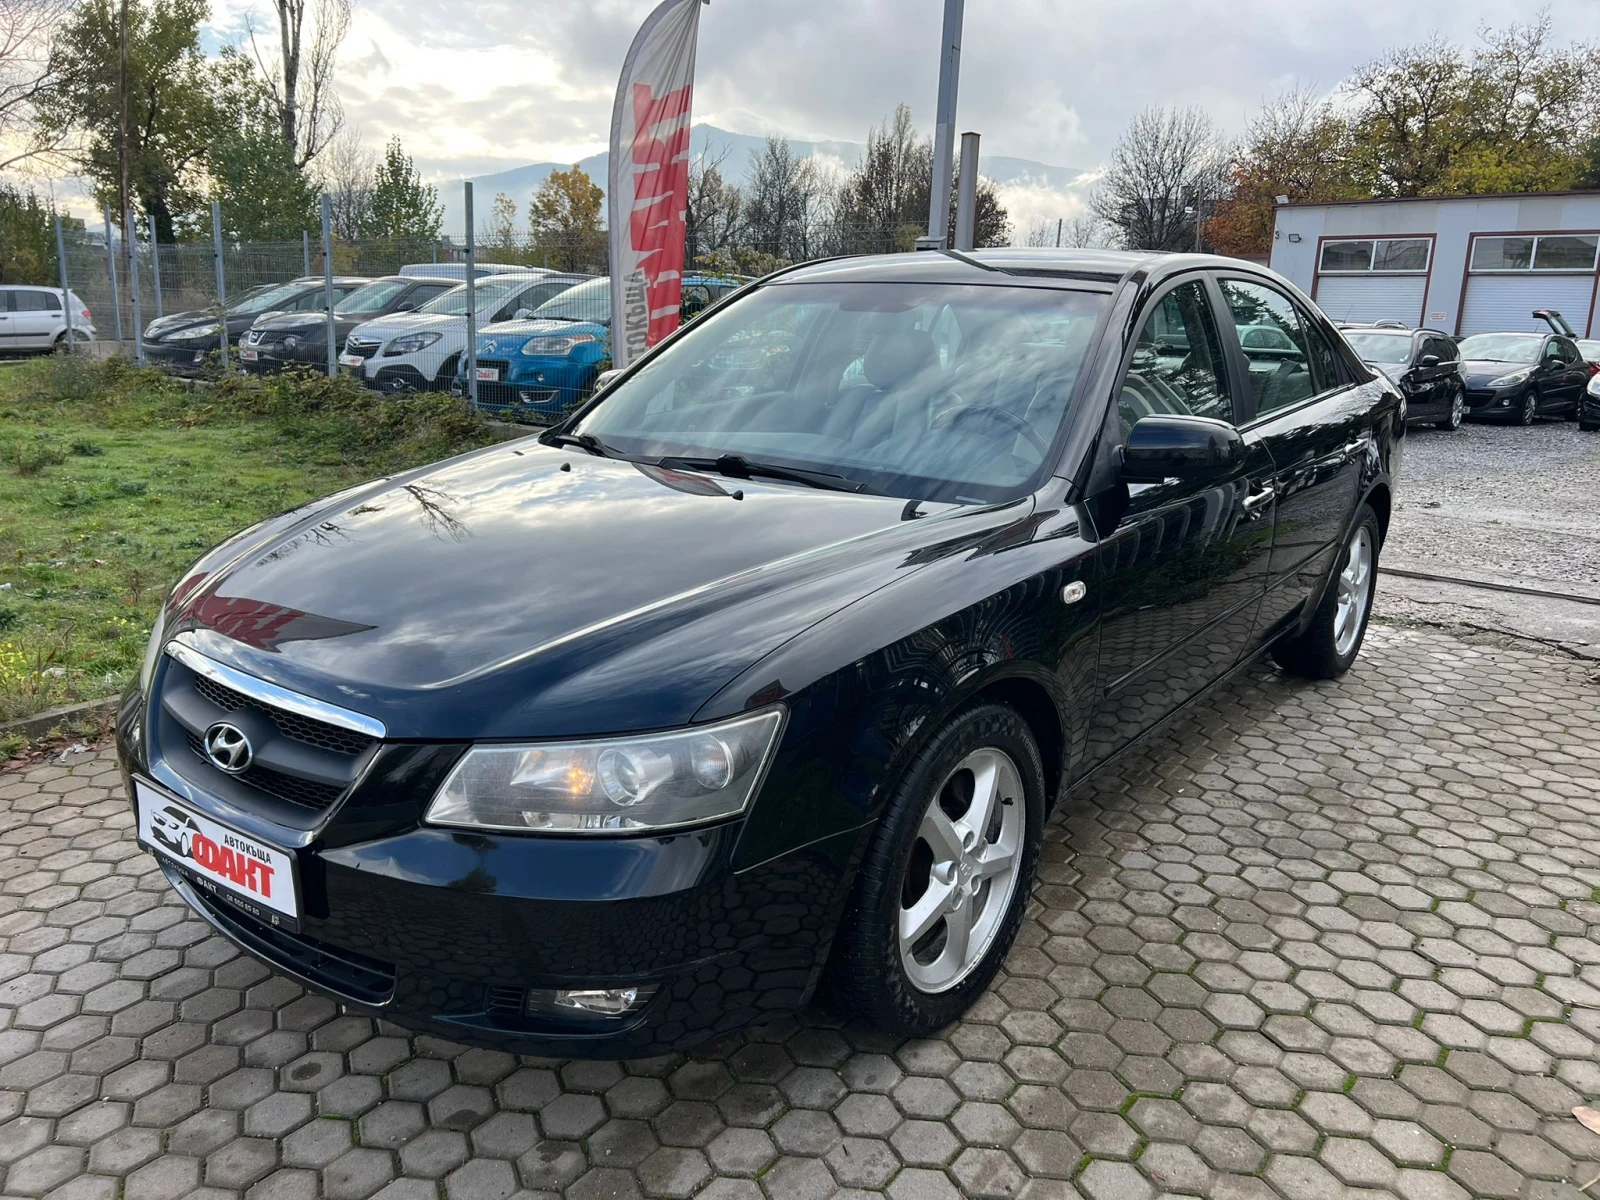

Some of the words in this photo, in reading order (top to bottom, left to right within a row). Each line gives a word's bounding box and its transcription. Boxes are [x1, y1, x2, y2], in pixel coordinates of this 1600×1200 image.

[623, 269, 648, 362] ТОКЪЩА
[191, 833, 275, 899] ФАКТ
[224, 834, 272, 864] АВТОКЪЩА
